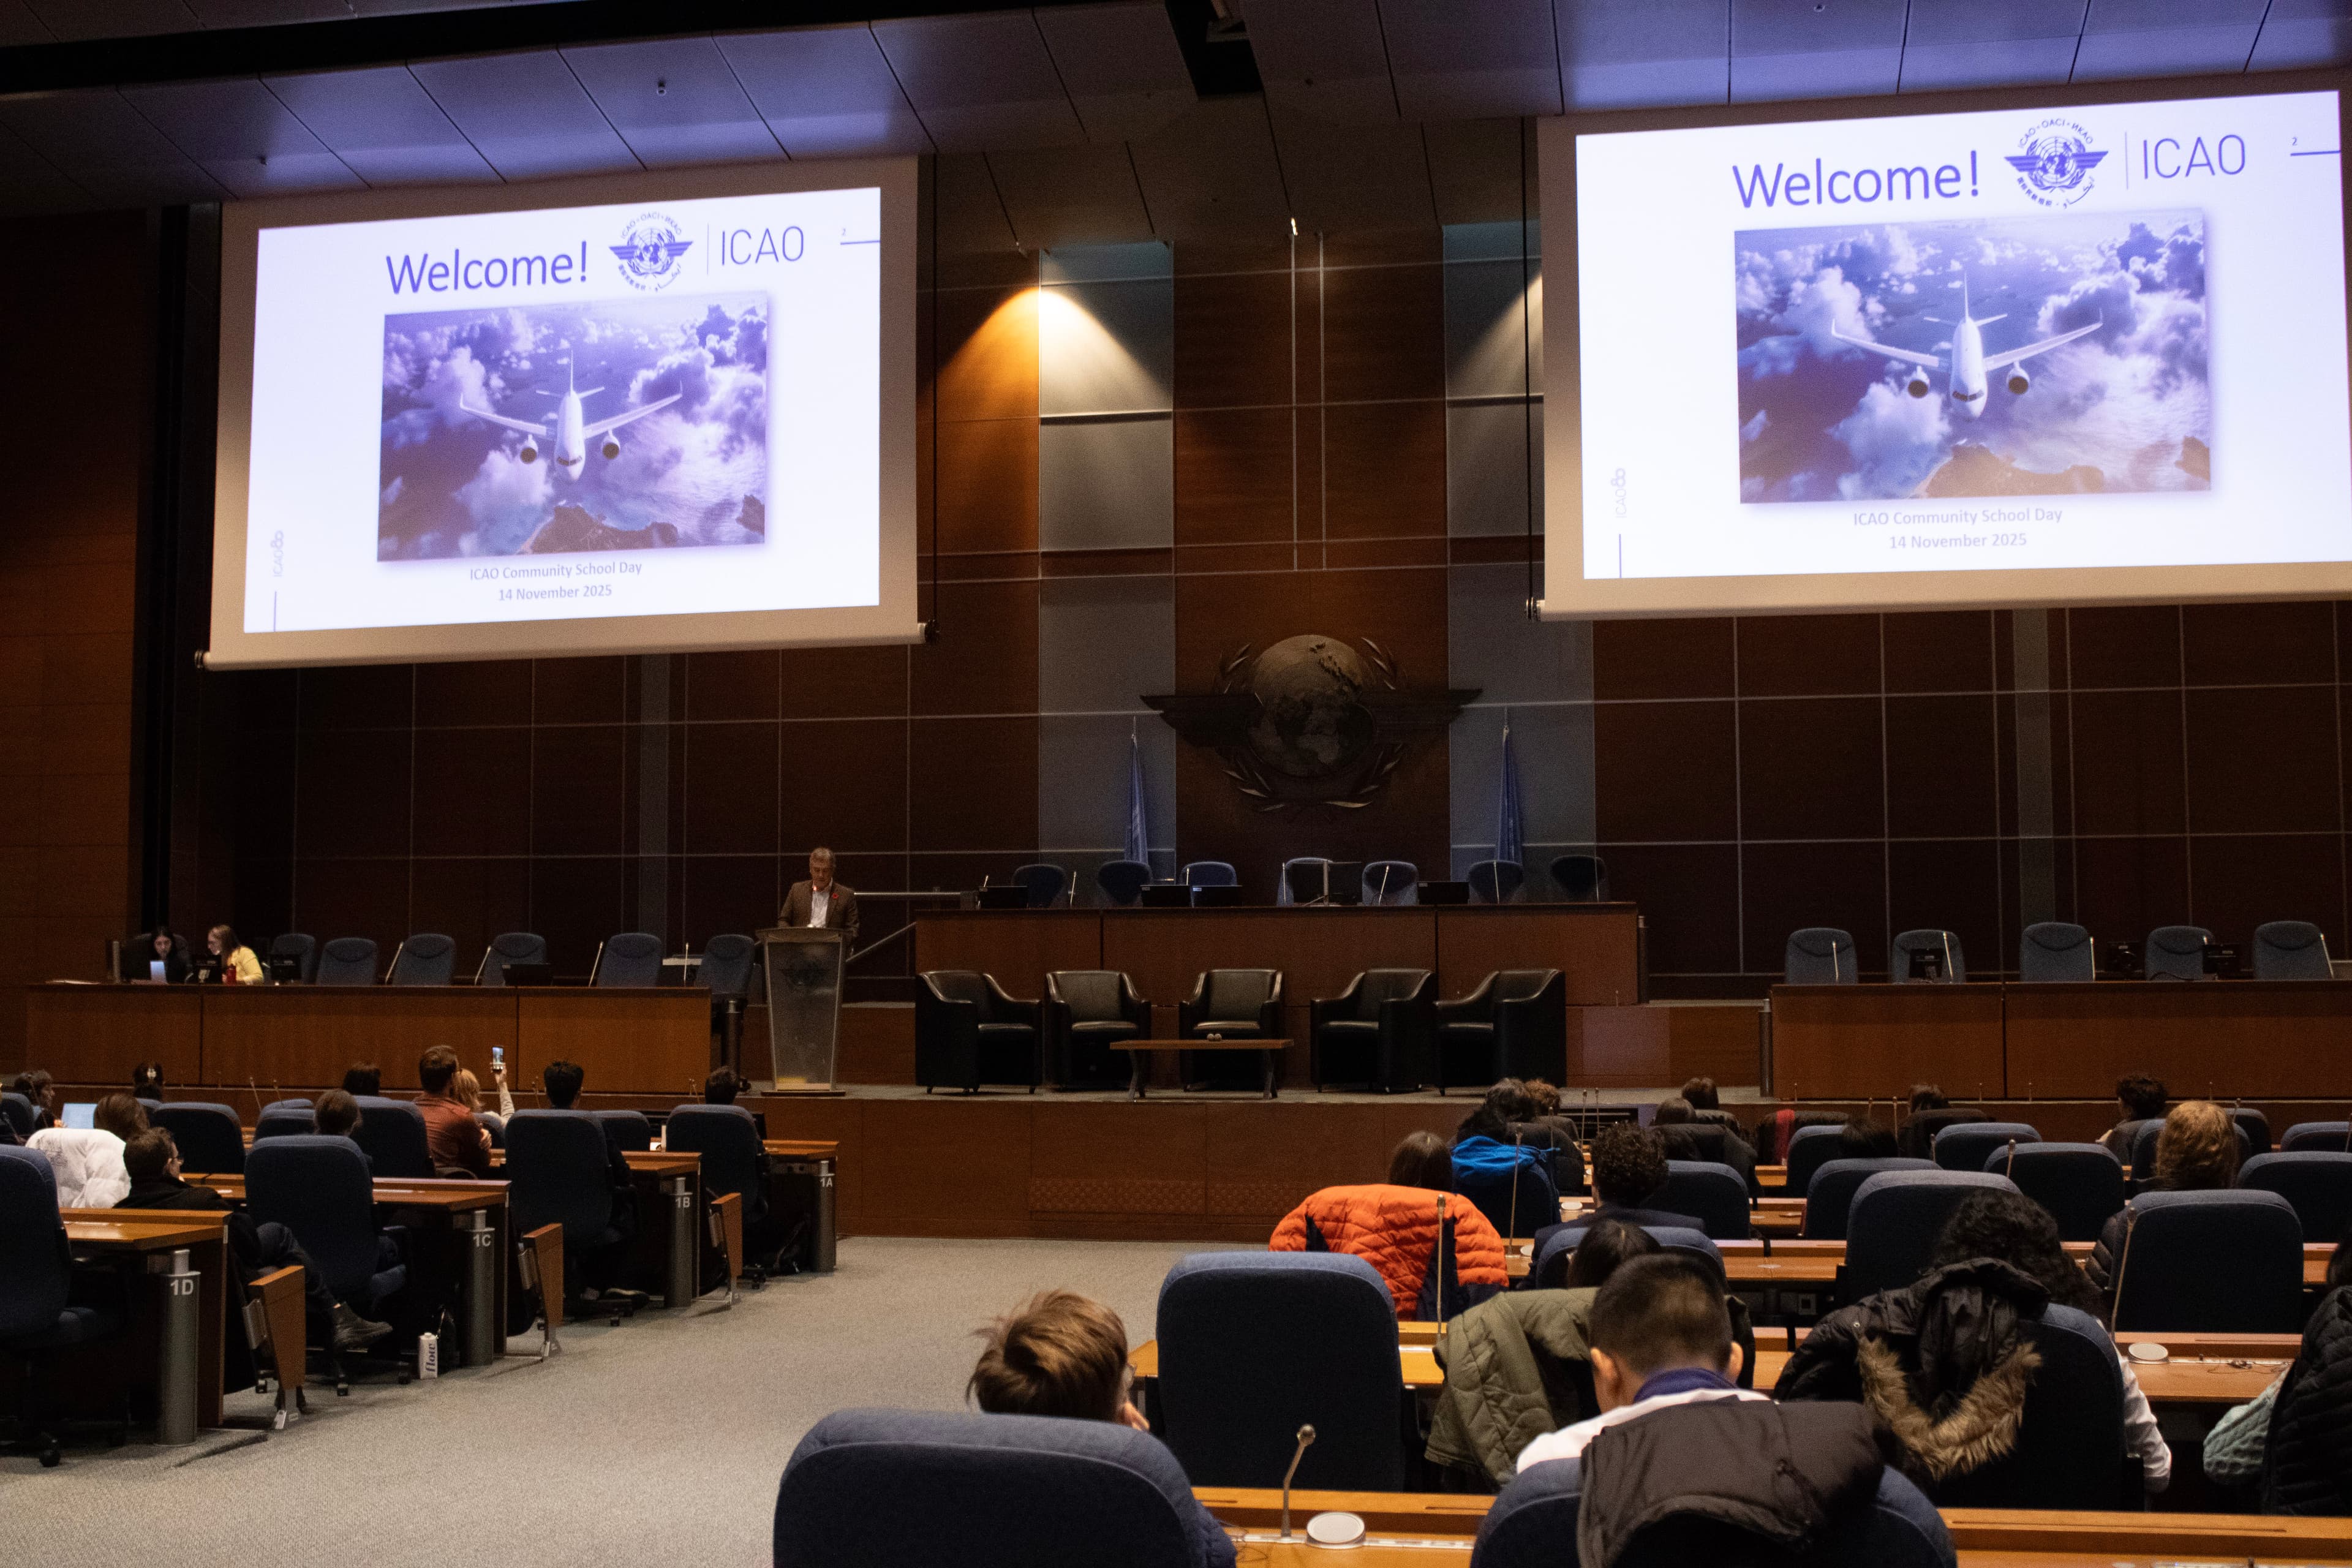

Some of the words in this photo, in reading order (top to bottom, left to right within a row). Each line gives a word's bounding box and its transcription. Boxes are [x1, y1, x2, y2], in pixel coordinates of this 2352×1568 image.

[2018, 127, 2036, 148] ICAO
[2041, 118, 2065, 128] OACI
[2071, 123, 2093, 144] ИКАО
[2291, 137, 2297, 146] 2
[2143, 134, 2245, 179] ICAO
[1732, 149, 1979, 208] Welcome!
[641, 211, 660, 221] OACI
[722, 225, 804, 265] ICAO
[386, 241, 587, 294] Welcome!
[1853, 513, 1889, 526] ICAO
[1893, 509, 1978, 525] Community
[1982, 508, 2030, 522] School
[2035, 508, 2062, 522] Day
[1890, 536, 1906, 549] 14
[1911, 533, 1987, 549] November
[1992, 533, 2027, 546] 2025
[470, 568, 499, 580] ICAO
[503, 564, 573, 579] Community
[576, 562, 616, 576] School
[619, 562, 642, 575] Day
[499, 589, 513, 601] 14
[516, 586, 579, 600] November
[583, 584, 612, 597] 2025
[820, 1177, 833, 1187] 1A
[675, 1197, 690, 1208] 1B
[473, 1234, 491, 1247] 1C
[170, 1280, 194, 1295] 1D
[426, 1343, 435, 1372] flow
